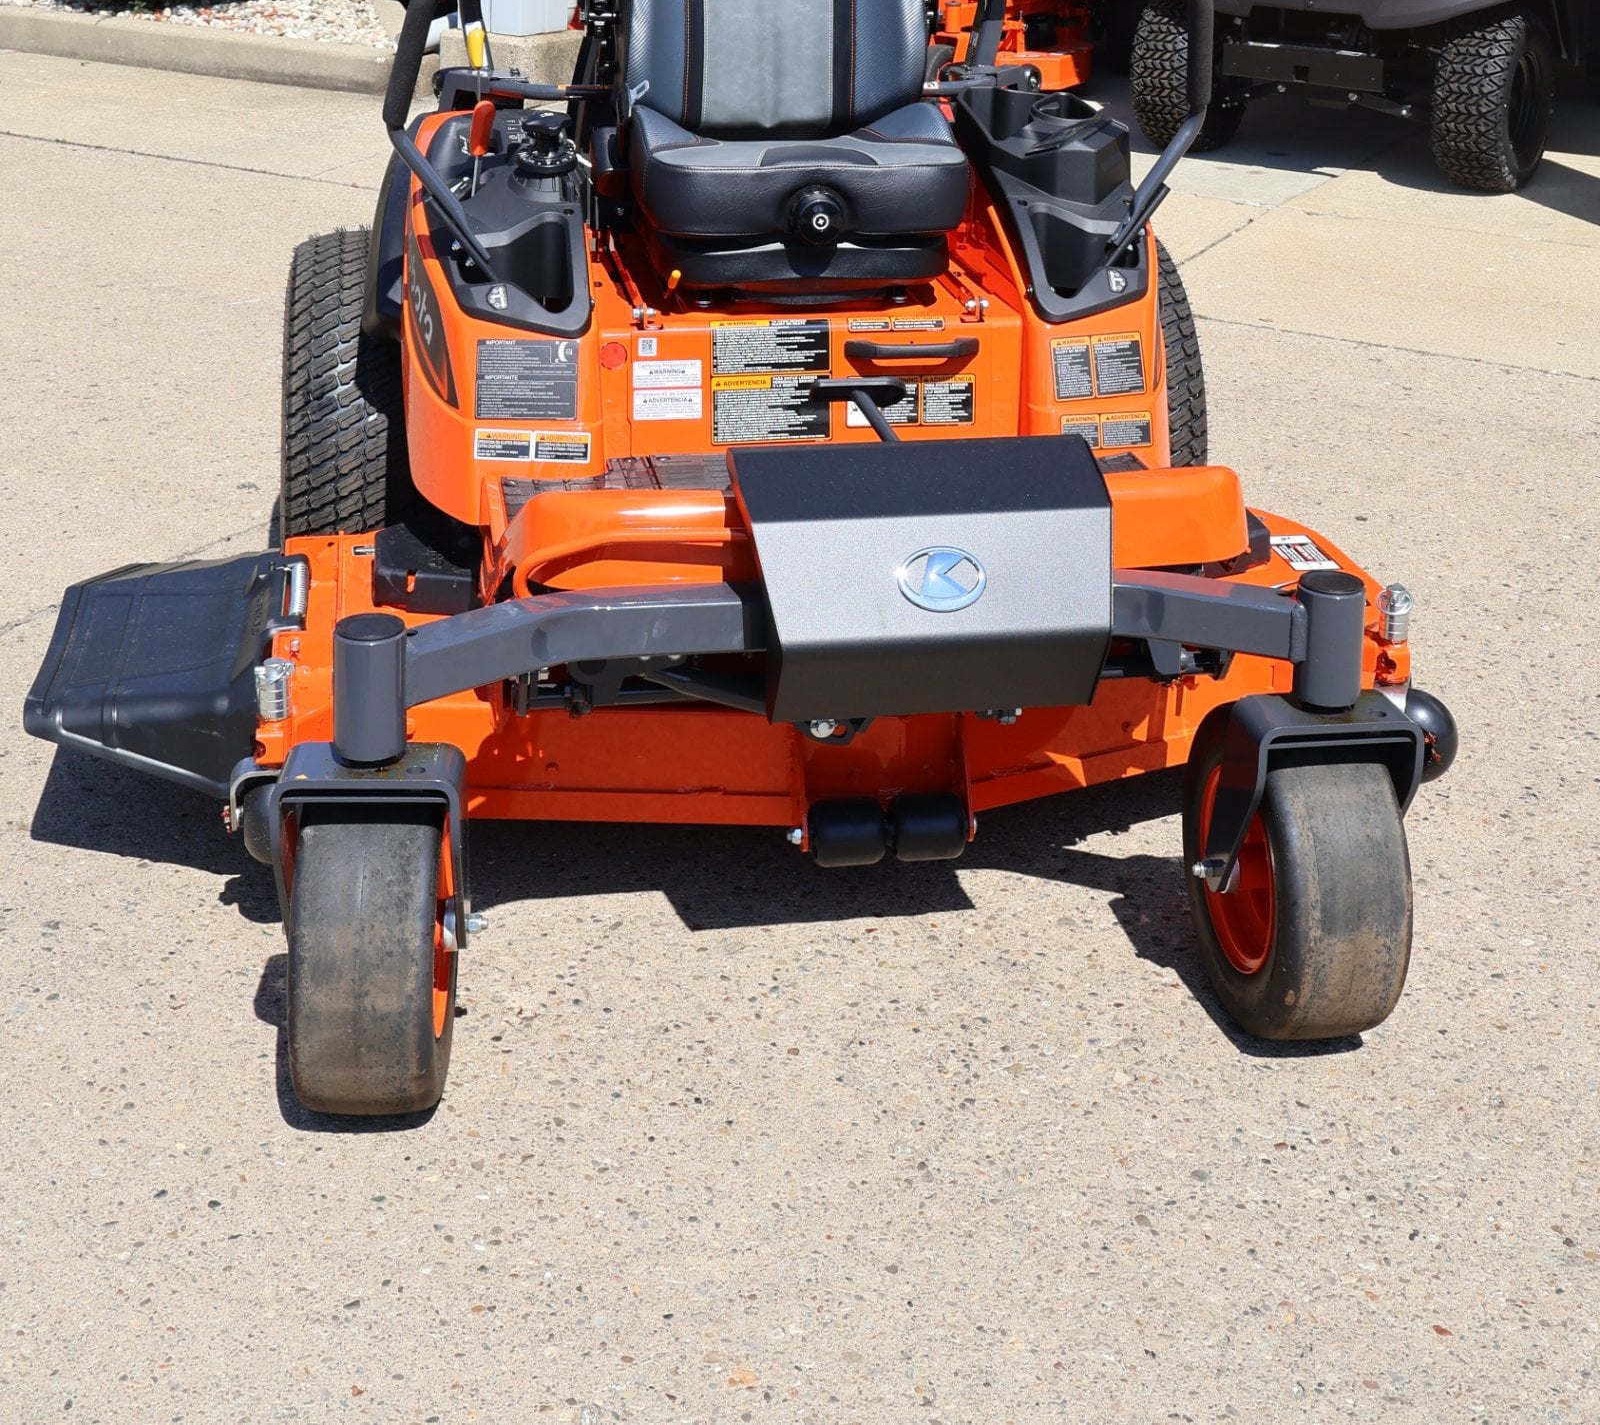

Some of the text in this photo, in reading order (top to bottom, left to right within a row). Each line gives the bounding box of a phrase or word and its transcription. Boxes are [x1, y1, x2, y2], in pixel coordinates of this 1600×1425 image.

[723, 379, 767, 387] ADVERTENCIA
[929, 375, 972, 383] ADVERTENCIA
[1110, 413, 1147, 421] ADVERTENCIA
